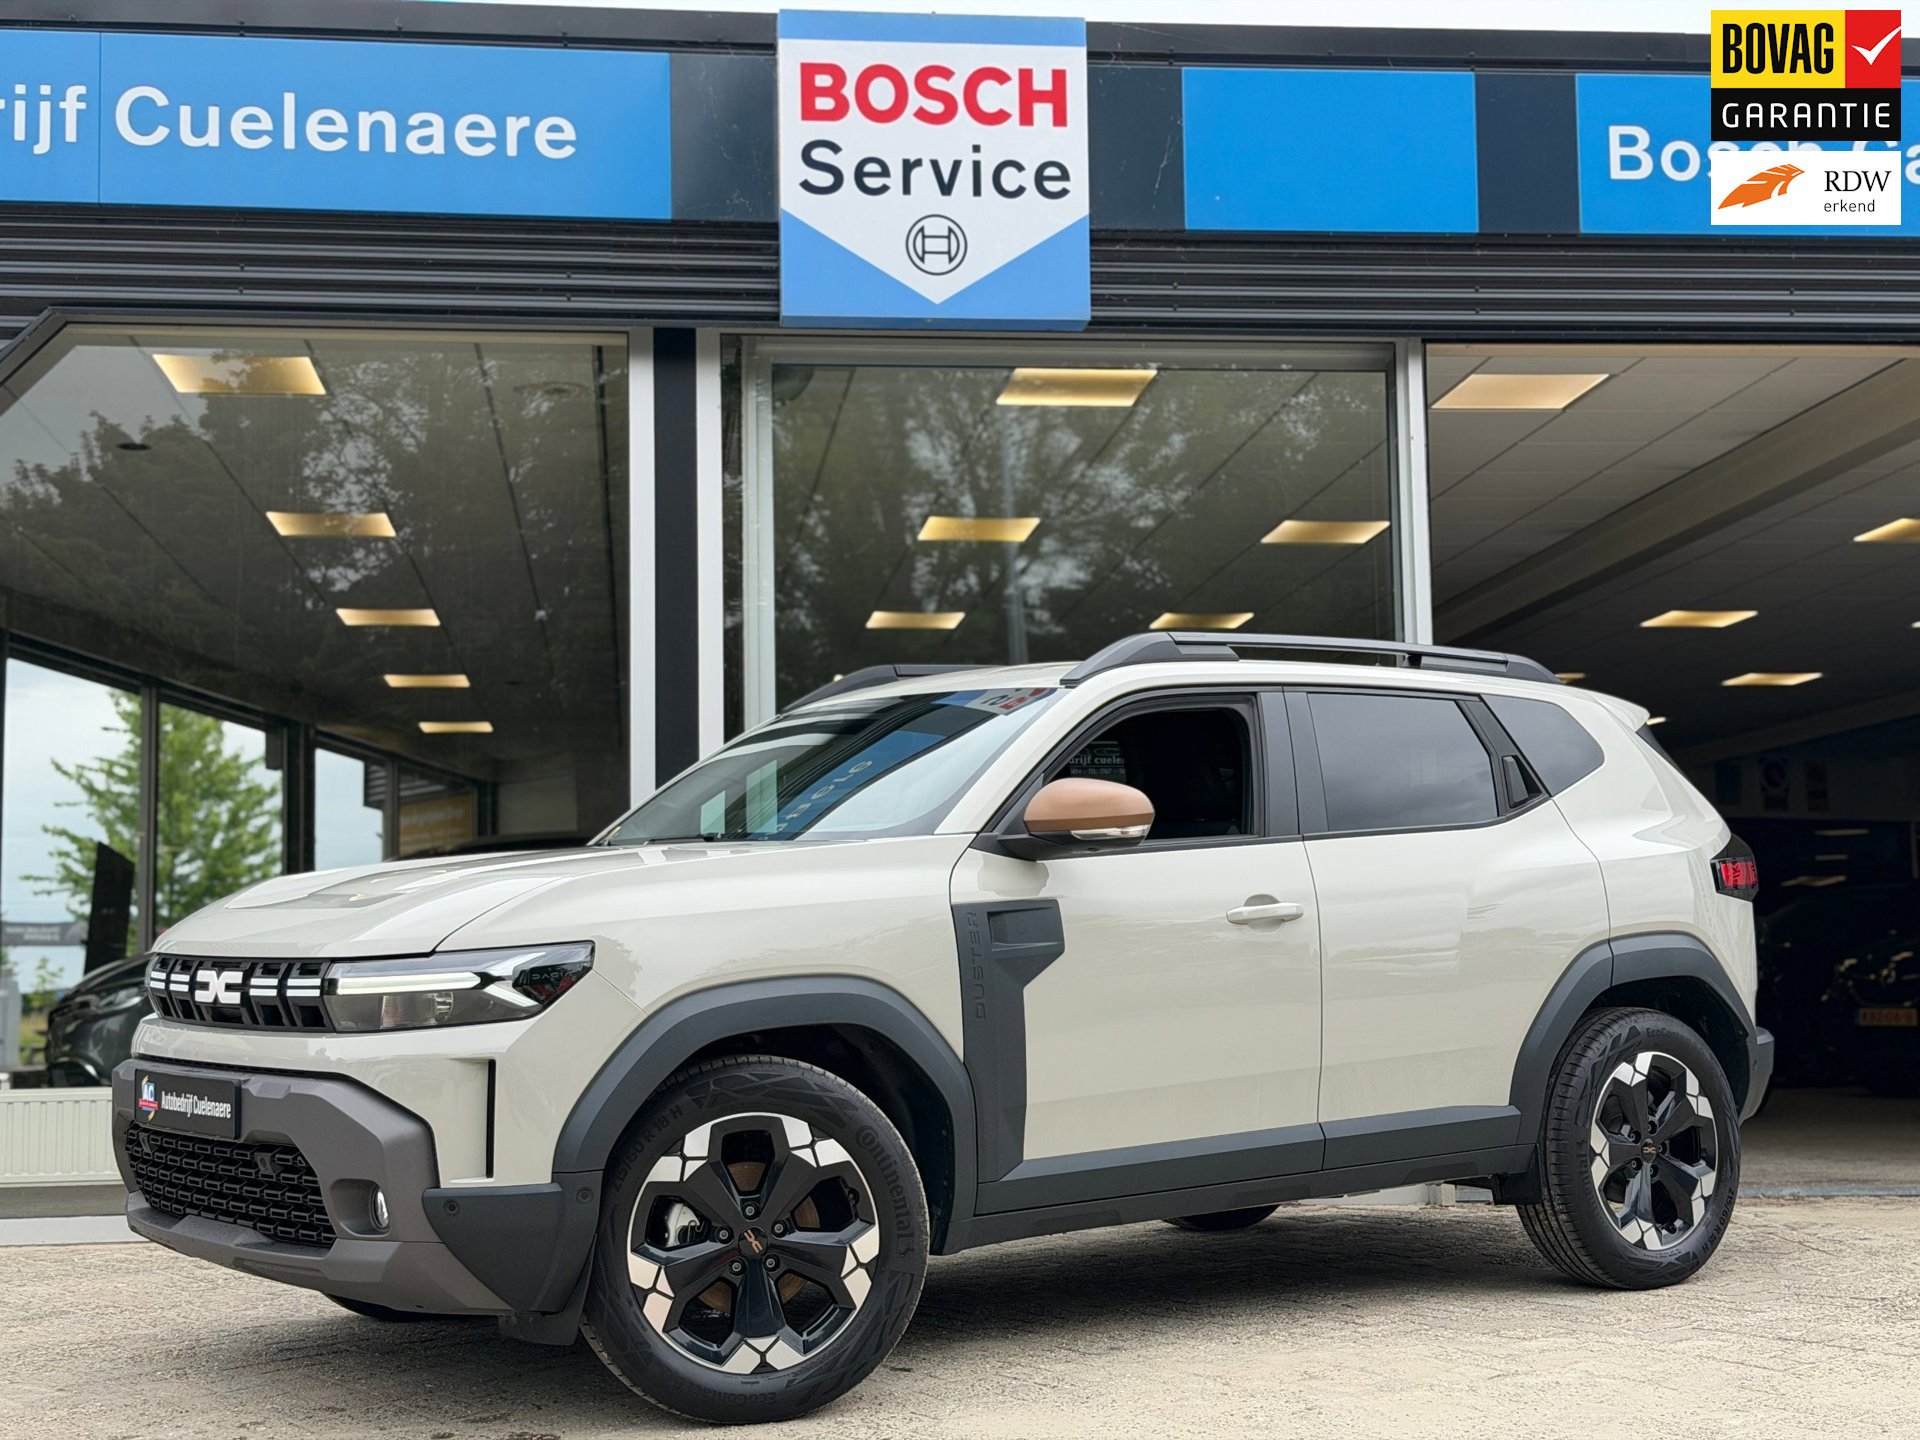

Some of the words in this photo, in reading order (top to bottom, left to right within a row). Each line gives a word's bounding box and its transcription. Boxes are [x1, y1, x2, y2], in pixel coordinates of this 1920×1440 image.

[115, 85, 577, 159] Cuelenaere
[800, 62, 1067, 128] BOSCH
[799, 139, 1071, 200] Service
[967, 911, 986, 1021] DUSTER
[161, 1091, 193, 1118] Autobedrijf
[193, 1095, 231, 1119] Cuelenaere
[855, 1125, 915, 1239] Continental
